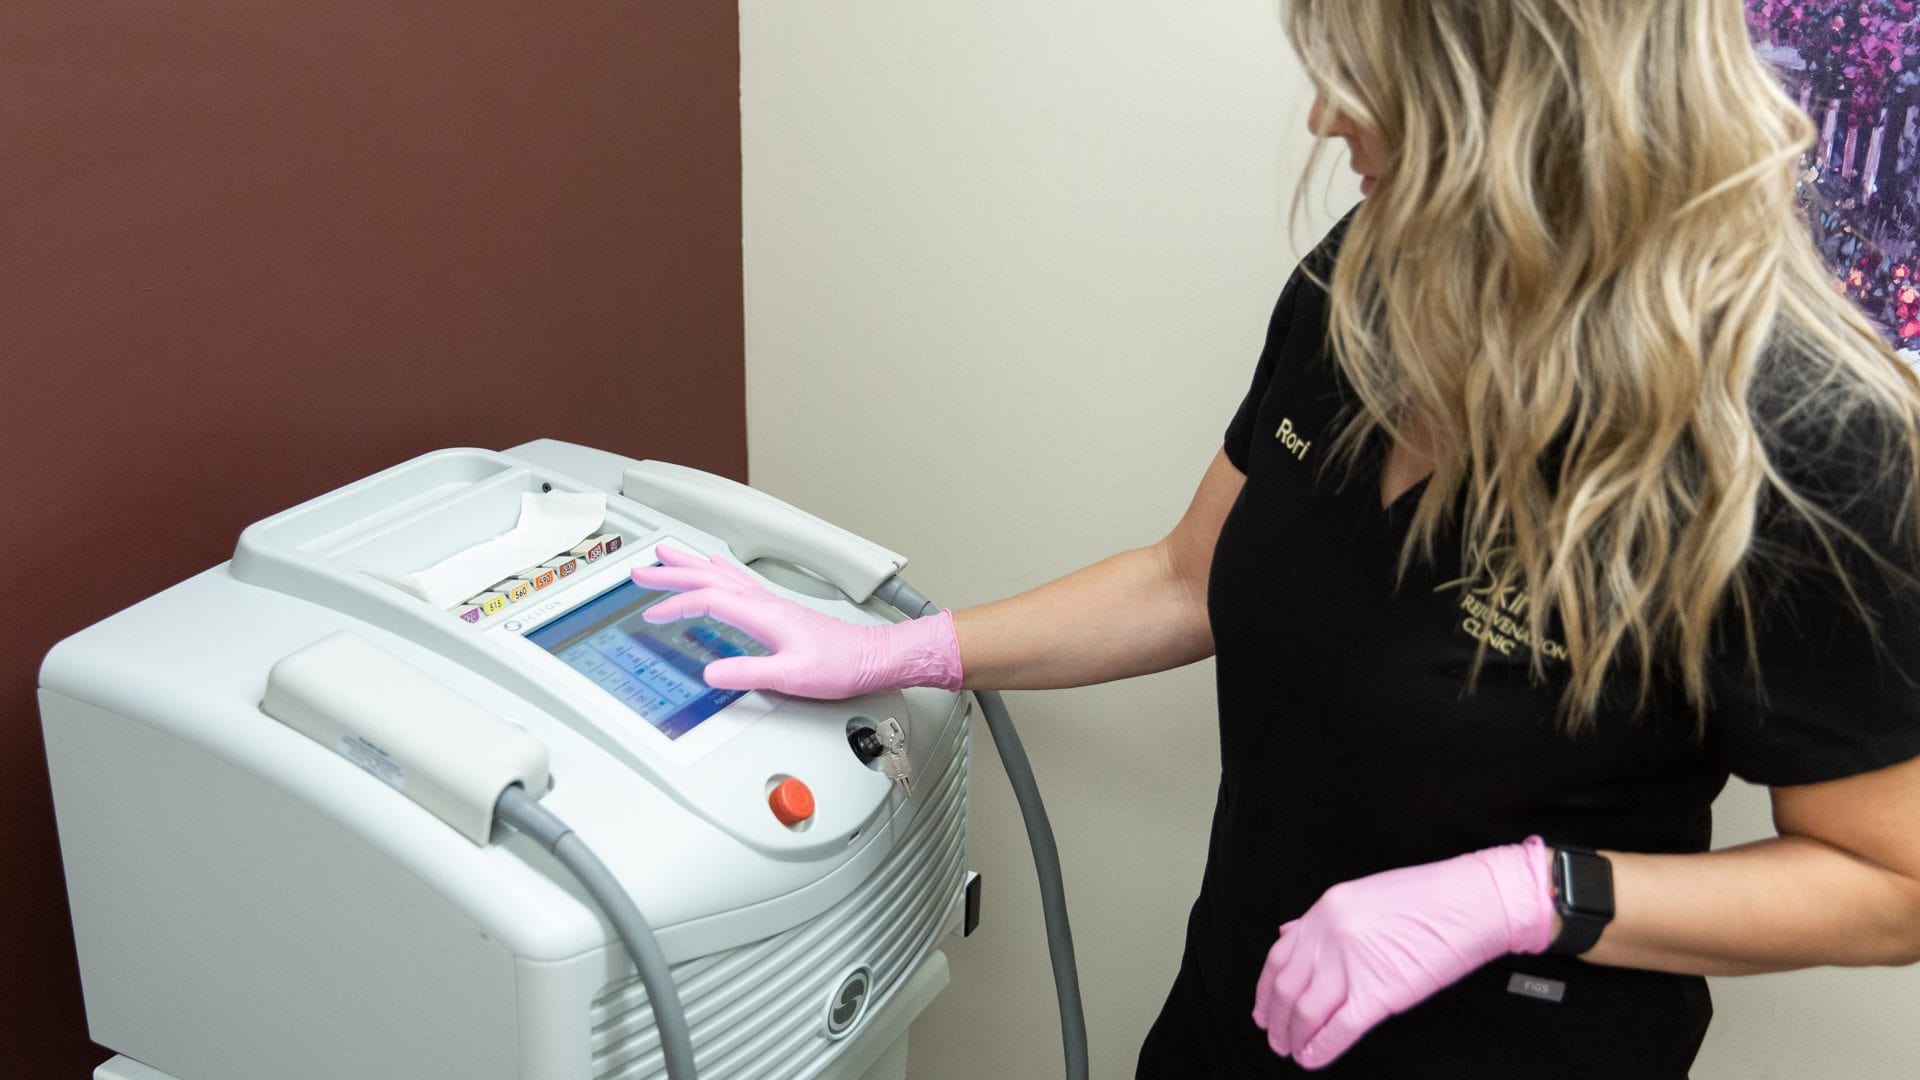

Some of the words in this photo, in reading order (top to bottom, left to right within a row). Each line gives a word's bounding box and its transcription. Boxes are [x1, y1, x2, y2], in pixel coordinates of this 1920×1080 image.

[1275, 417, 1311, 460] Rori
[489, 600, 502, 611] 515
[515, 587, 527, 600] 560
[539, 574, 551, 587] 590
[1524, 980, 1550, 994] FIGS
